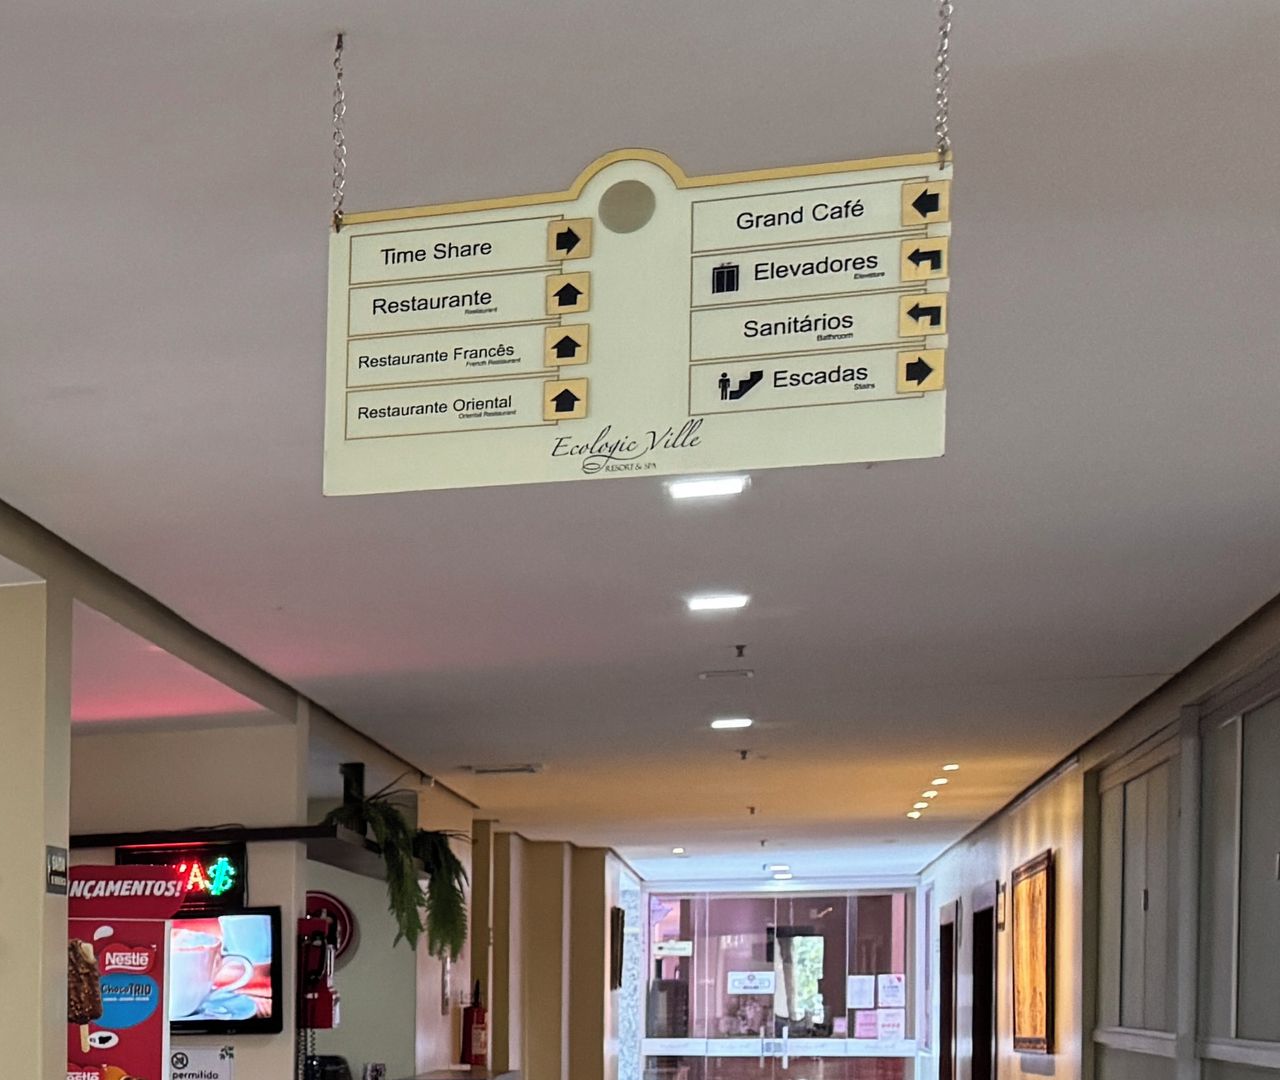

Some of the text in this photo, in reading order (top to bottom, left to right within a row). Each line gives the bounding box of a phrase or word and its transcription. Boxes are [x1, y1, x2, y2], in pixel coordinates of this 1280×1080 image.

[736, 199, 864, 229] Grand Café
[381, 242, 492, 265] Time Share
[754, 255, 878, 281] Elevadores
[372, 290, 492, 315] Restaurante
[743, 313, 854, 338] Sanitários
[358, 344, 515, 369] Restaurante Francês
[773, 366, 868, 388] Escadas
[358, 395, 512, 420] Restaurante Oriental
[551, 418, 704, 466] Ecologic Ville
[69, 880, 182, 899] NÇAMENTOS!
[173, 1071, 219, 1080] permitido
